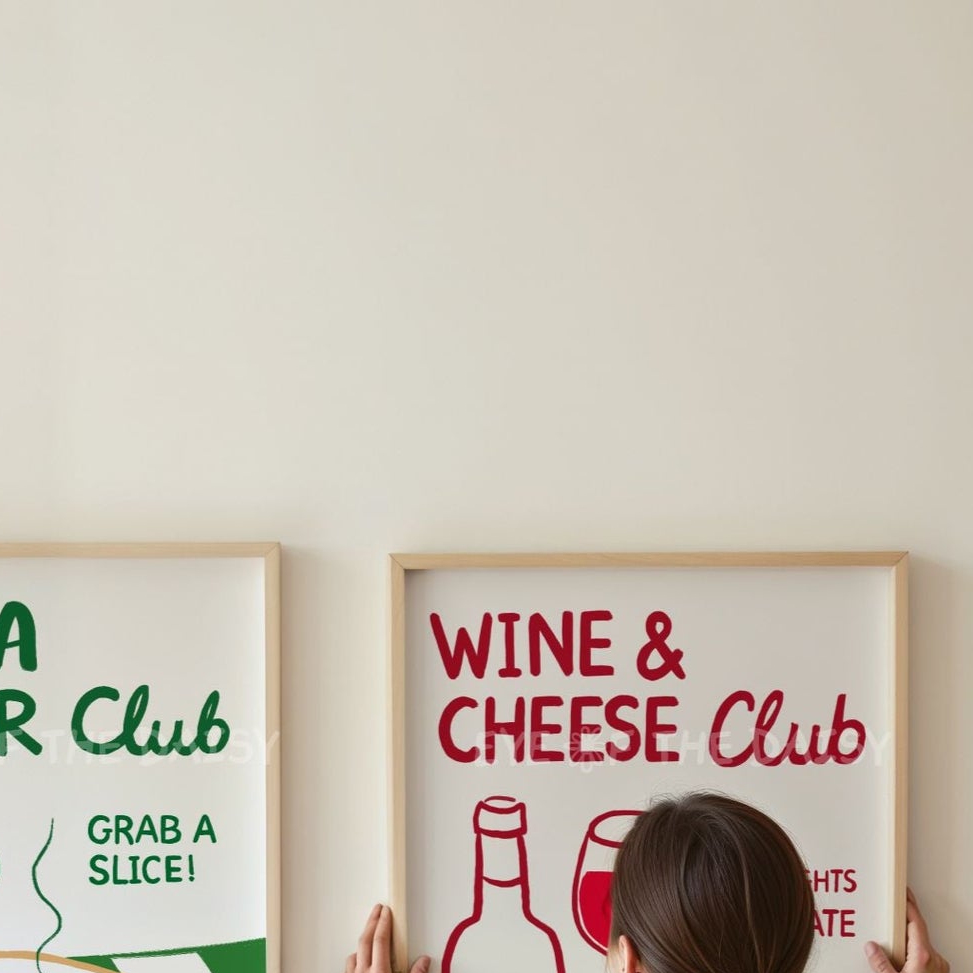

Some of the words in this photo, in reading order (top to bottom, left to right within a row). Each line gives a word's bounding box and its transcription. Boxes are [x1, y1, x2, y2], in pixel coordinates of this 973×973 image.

[430, 610, 615, 680] WINE
[636, 611, 686, 681] &
[72, 686, 231, 757] Club
[438, 694, 680, 764] CHEESE
[709, 689, 867, 768] Club
[88, 815, 181, 844] GRAB
[193, 815, 217, 844] A
[88, 854, 196, 885] SLICE!
